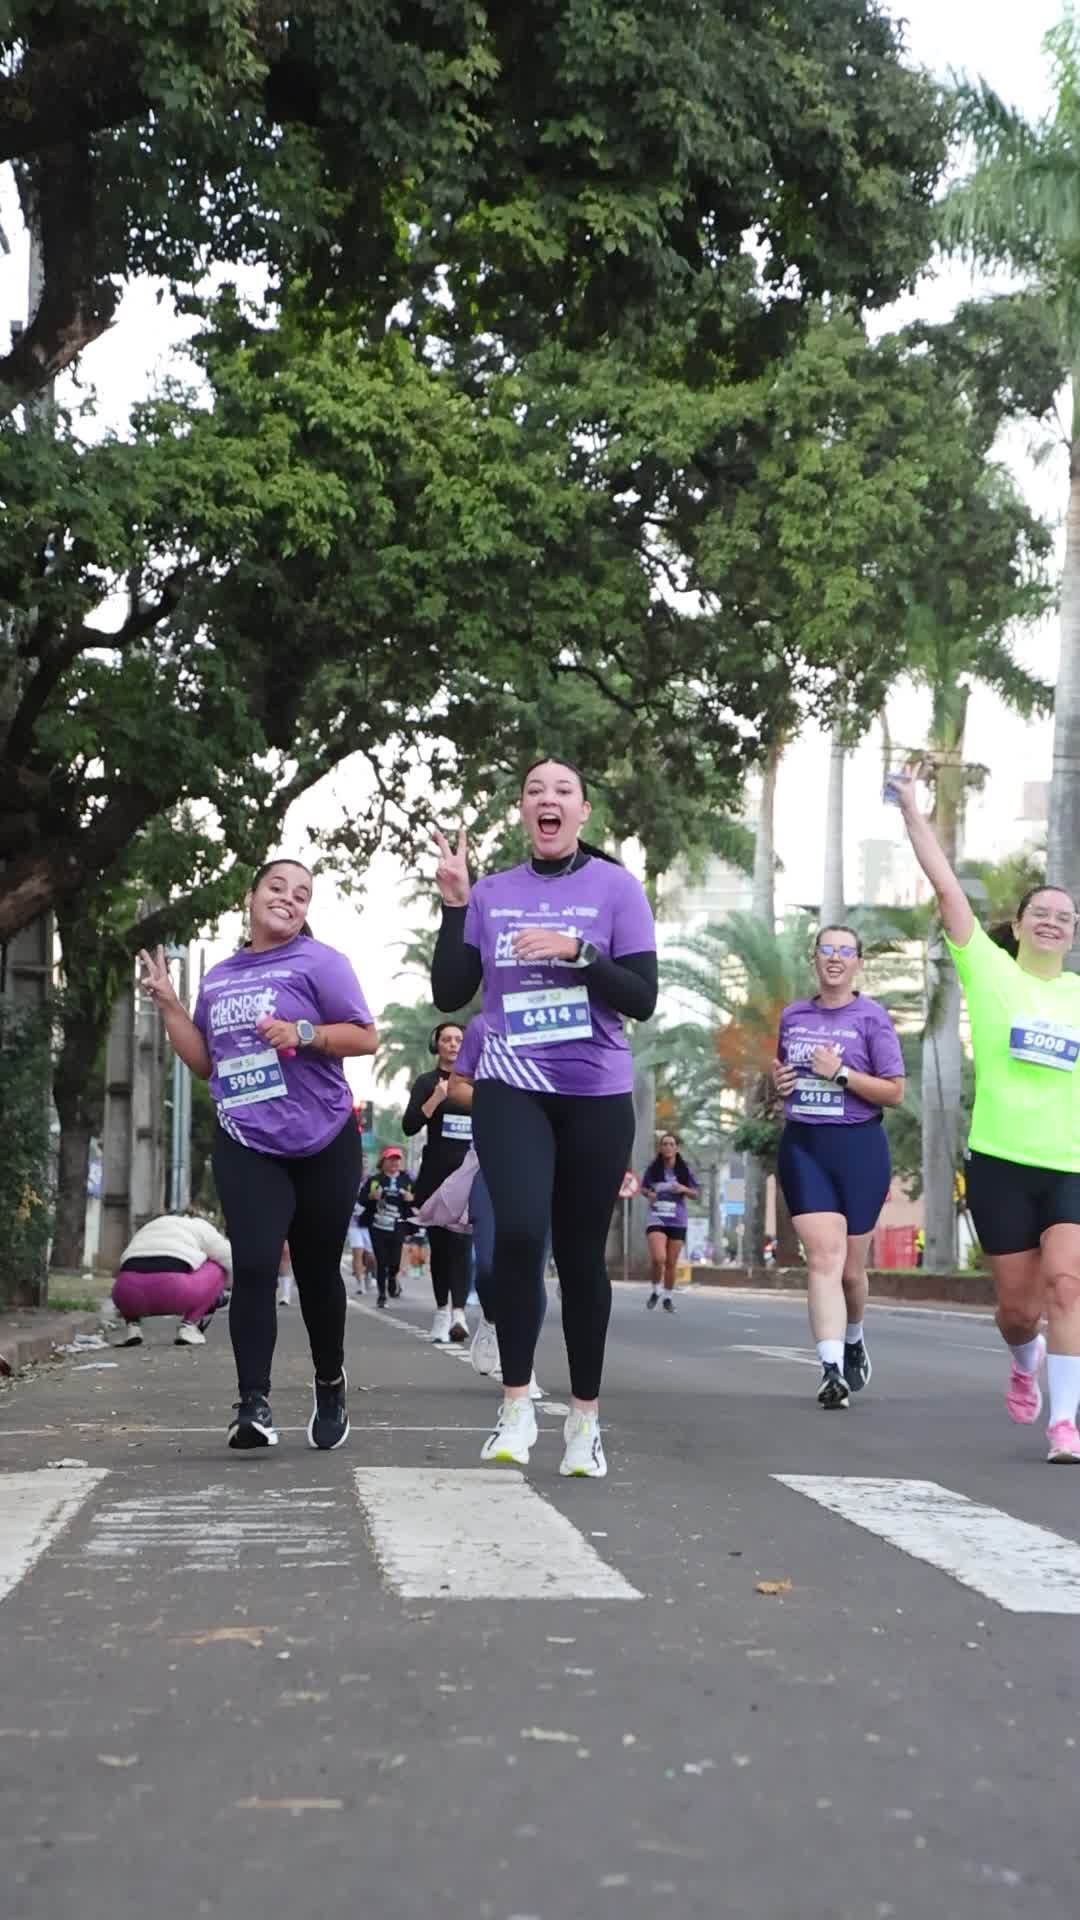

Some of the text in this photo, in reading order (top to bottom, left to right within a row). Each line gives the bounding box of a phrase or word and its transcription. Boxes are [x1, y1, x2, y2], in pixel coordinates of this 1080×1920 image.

[210, 994, 264, 1018] MUNDO
[523, 1006, 571, 1027] 6414
[211, 1008, 258, 1029] MELHO
[1023, 1031, 1066, 1052] 5008
[229, 1070, 266, 1090] 5960
[800, 1092, 831, 1103] 6418
